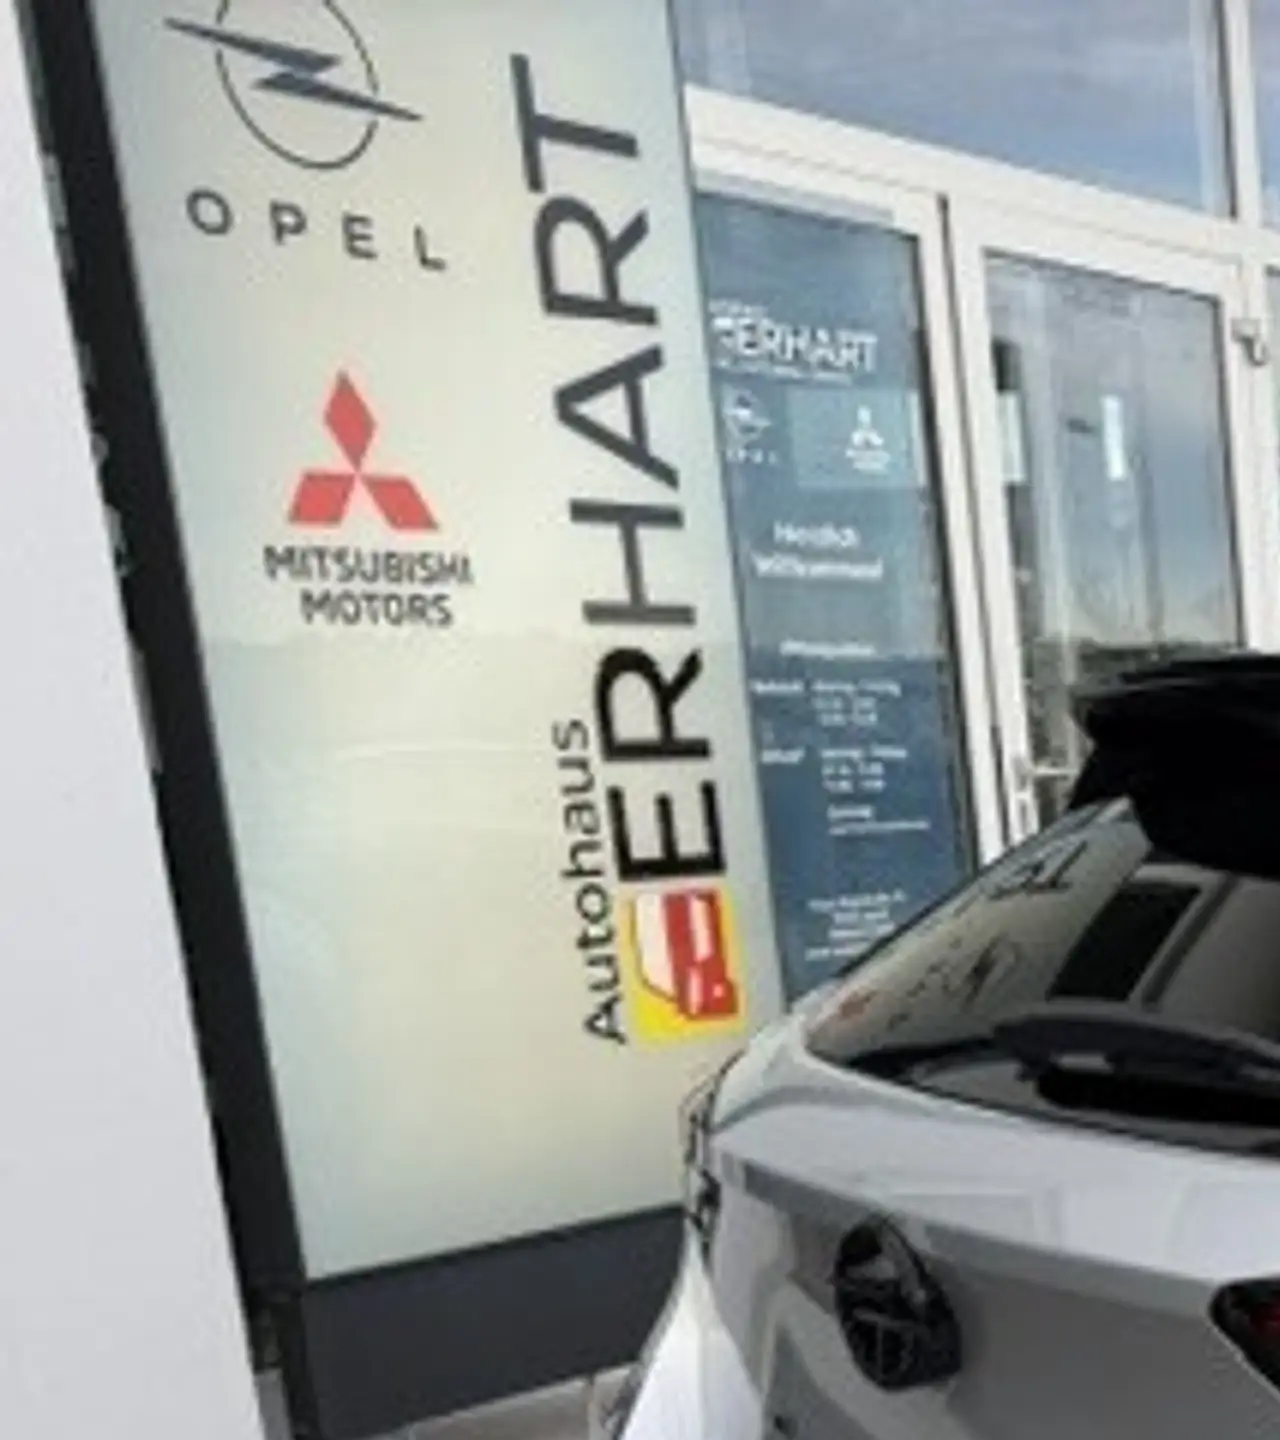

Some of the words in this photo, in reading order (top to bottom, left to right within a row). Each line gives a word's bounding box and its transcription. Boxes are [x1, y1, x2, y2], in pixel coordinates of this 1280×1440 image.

[186, 188, 447, 271] OPEL
[511, 53, 727, 882] ERHART
[264, 544, 473, 586] MITSUBISHI
[302, 591, 454, 627] MOTORS
[551, 718, 627, 1045] Autohaus
